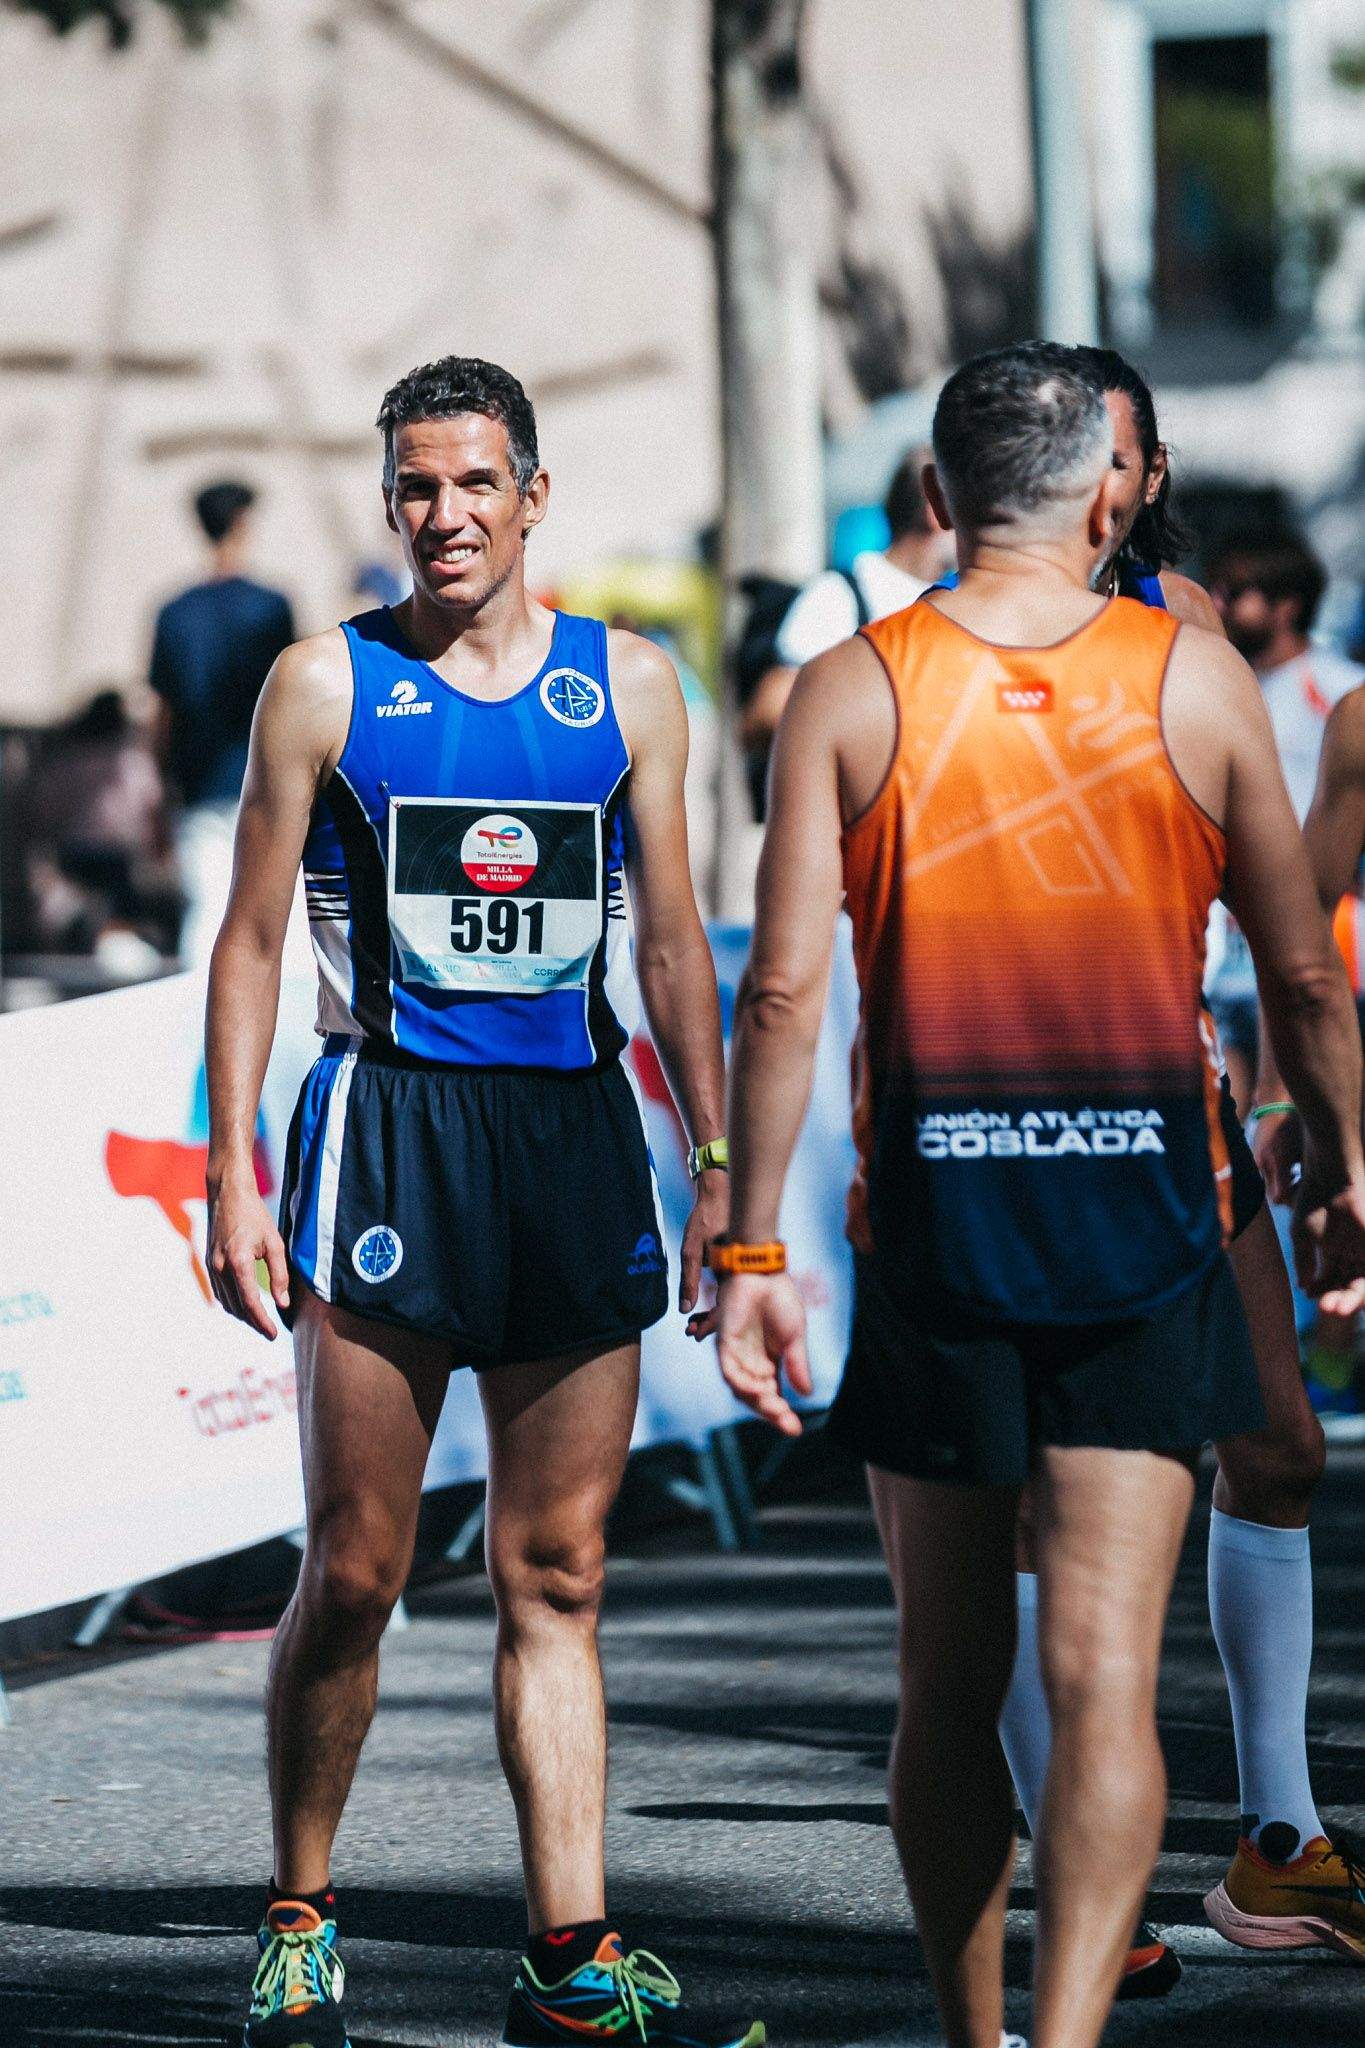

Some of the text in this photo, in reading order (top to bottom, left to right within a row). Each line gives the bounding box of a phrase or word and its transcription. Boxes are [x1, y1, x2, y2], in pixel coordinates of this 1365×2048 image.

[376, 701, 433, 718] VIATOR
[477, 851, 523, 860] TotalEnergies
[476, 873, 523, 883] DE MADRID
[486, 865, 514, 874] MILLA
[450, 898, 545, 955] 591
[1019, 1106, 1166, 1129] ATLÉTICA
[918, 1127, 1167, 1159] COSLADA
